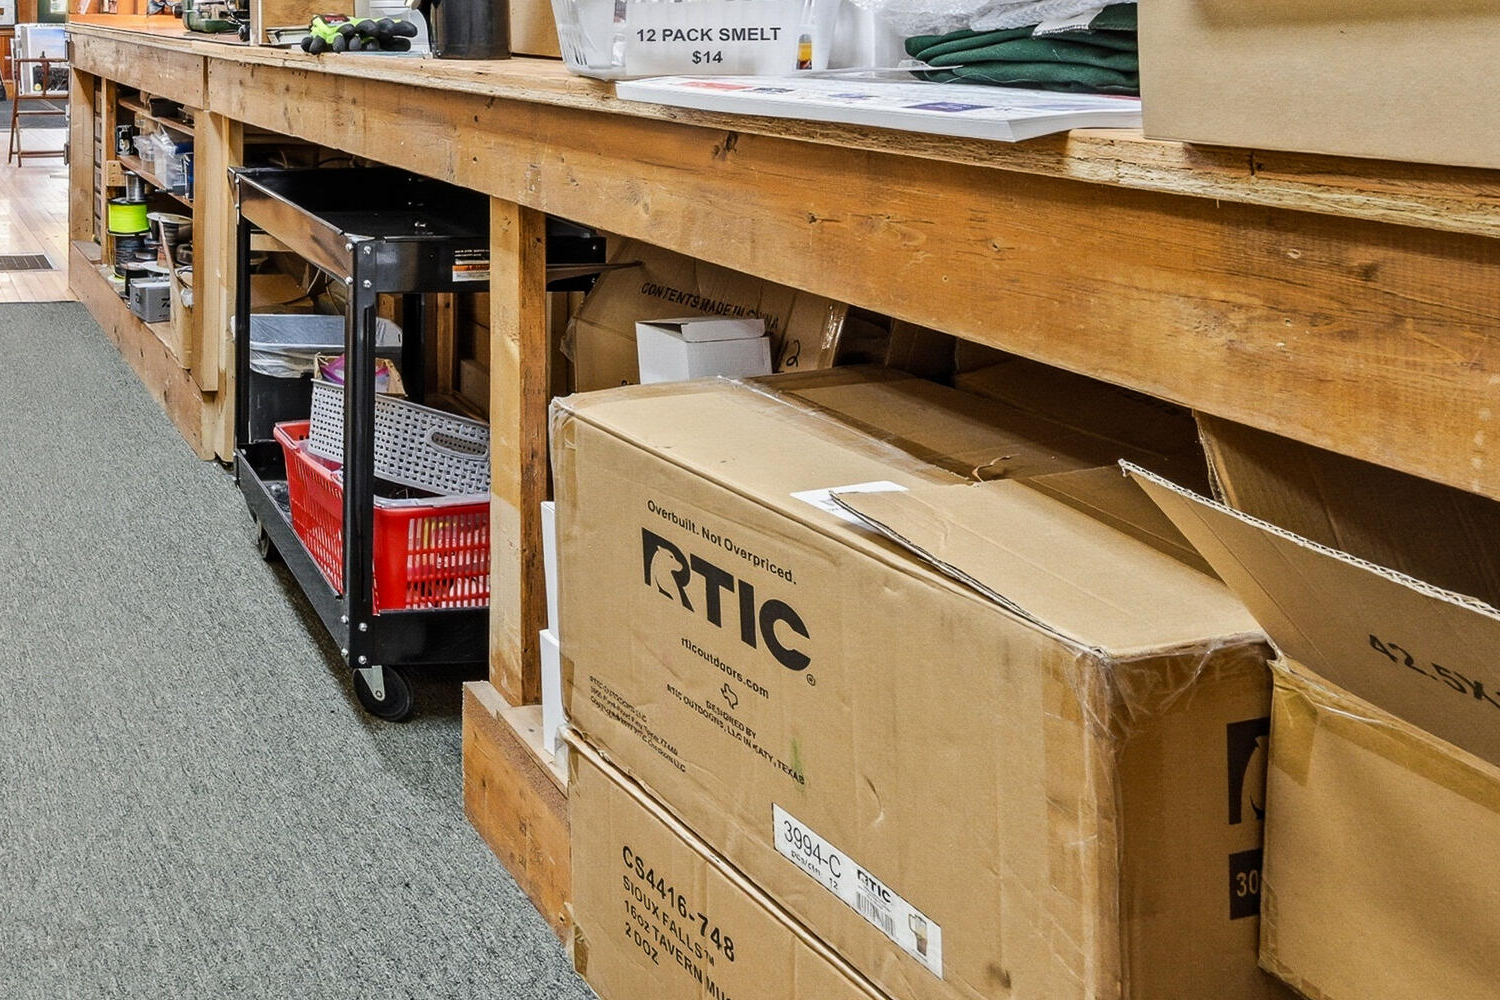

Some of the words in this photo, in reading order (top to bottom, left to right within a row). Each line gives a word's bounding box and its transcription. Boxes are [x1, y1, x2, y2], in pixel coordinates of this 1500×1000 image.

[636, 28, 657, 42] 12
[662, 28, 713, 42] PACK
[718, 27, 782, 42] SMELT
[691, 50, 723, 65] $14
[640, 282, 700, 309] CONTENTS
[699, 298, 731, 317] MADE
[732, 305, 745, 318] IN
[647, 499, 699, 535] Overbuilt.
[701, 526, 722, 548] Not
[724, 538, 797, 585] Overpriced.
[641, 526, 812, 672] RTIC
[681, 637, 769, 699] rticoutdoors.com
[705, 700, 745, 732] DESIGNED
[783, 819, 842, 880] 3994-C
[622, 845, 736, 963] CS4416-748
[623, 874, 661, 920] SIOUX
[624, 921, 633, 938] 2
[634, 930, 660, 967] DOZ
[653, 921, 703, 985] TAVERN
[705, 975, 732, 1000] MU
